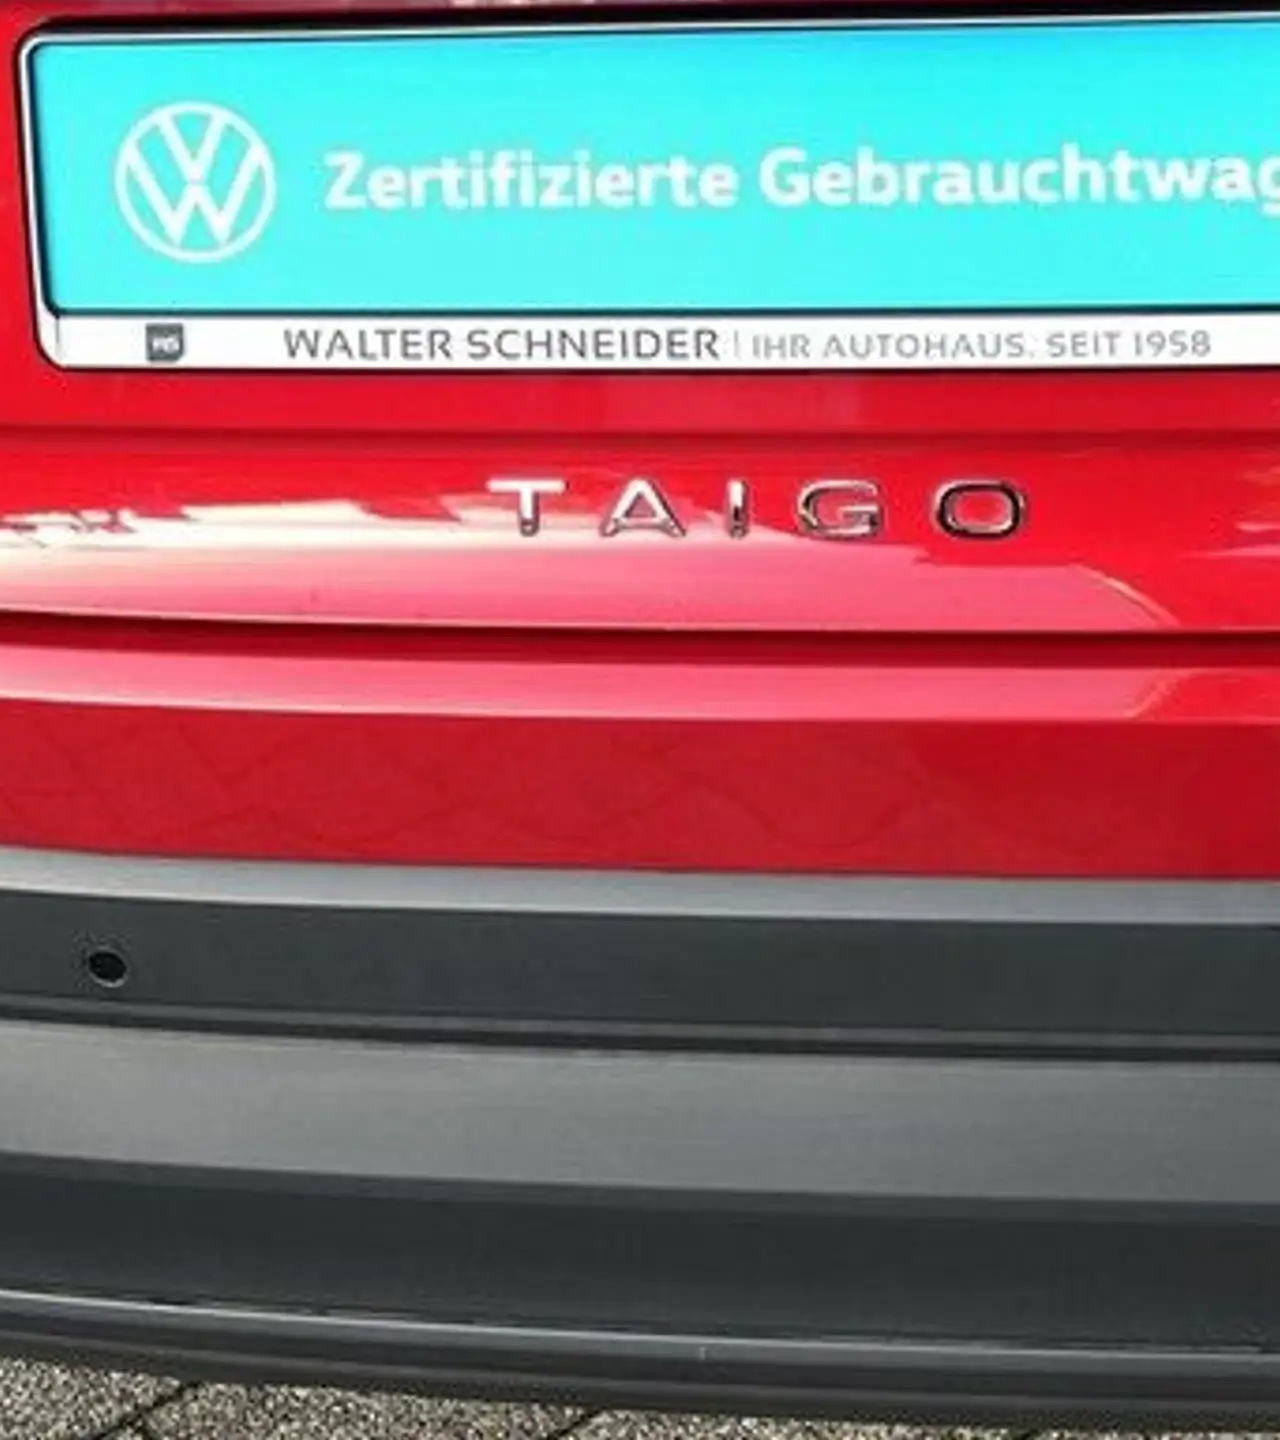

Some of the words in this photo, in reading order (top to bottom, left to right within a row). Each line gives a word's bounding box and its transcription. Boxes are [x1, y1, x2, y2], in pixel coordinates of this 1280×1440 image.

[323, 150, 737, 210] Zertifizierte
[283, 328, 455, 361] WALTER
[466, 325, 719, 360] SCHNEIDER
[752, 334, 811, 359] IHR
[1045, 331, 1121, 357] SEIT
[1134, 329, 1212, 357] 1958
[487, 477, 1026, 538] TAIGO
